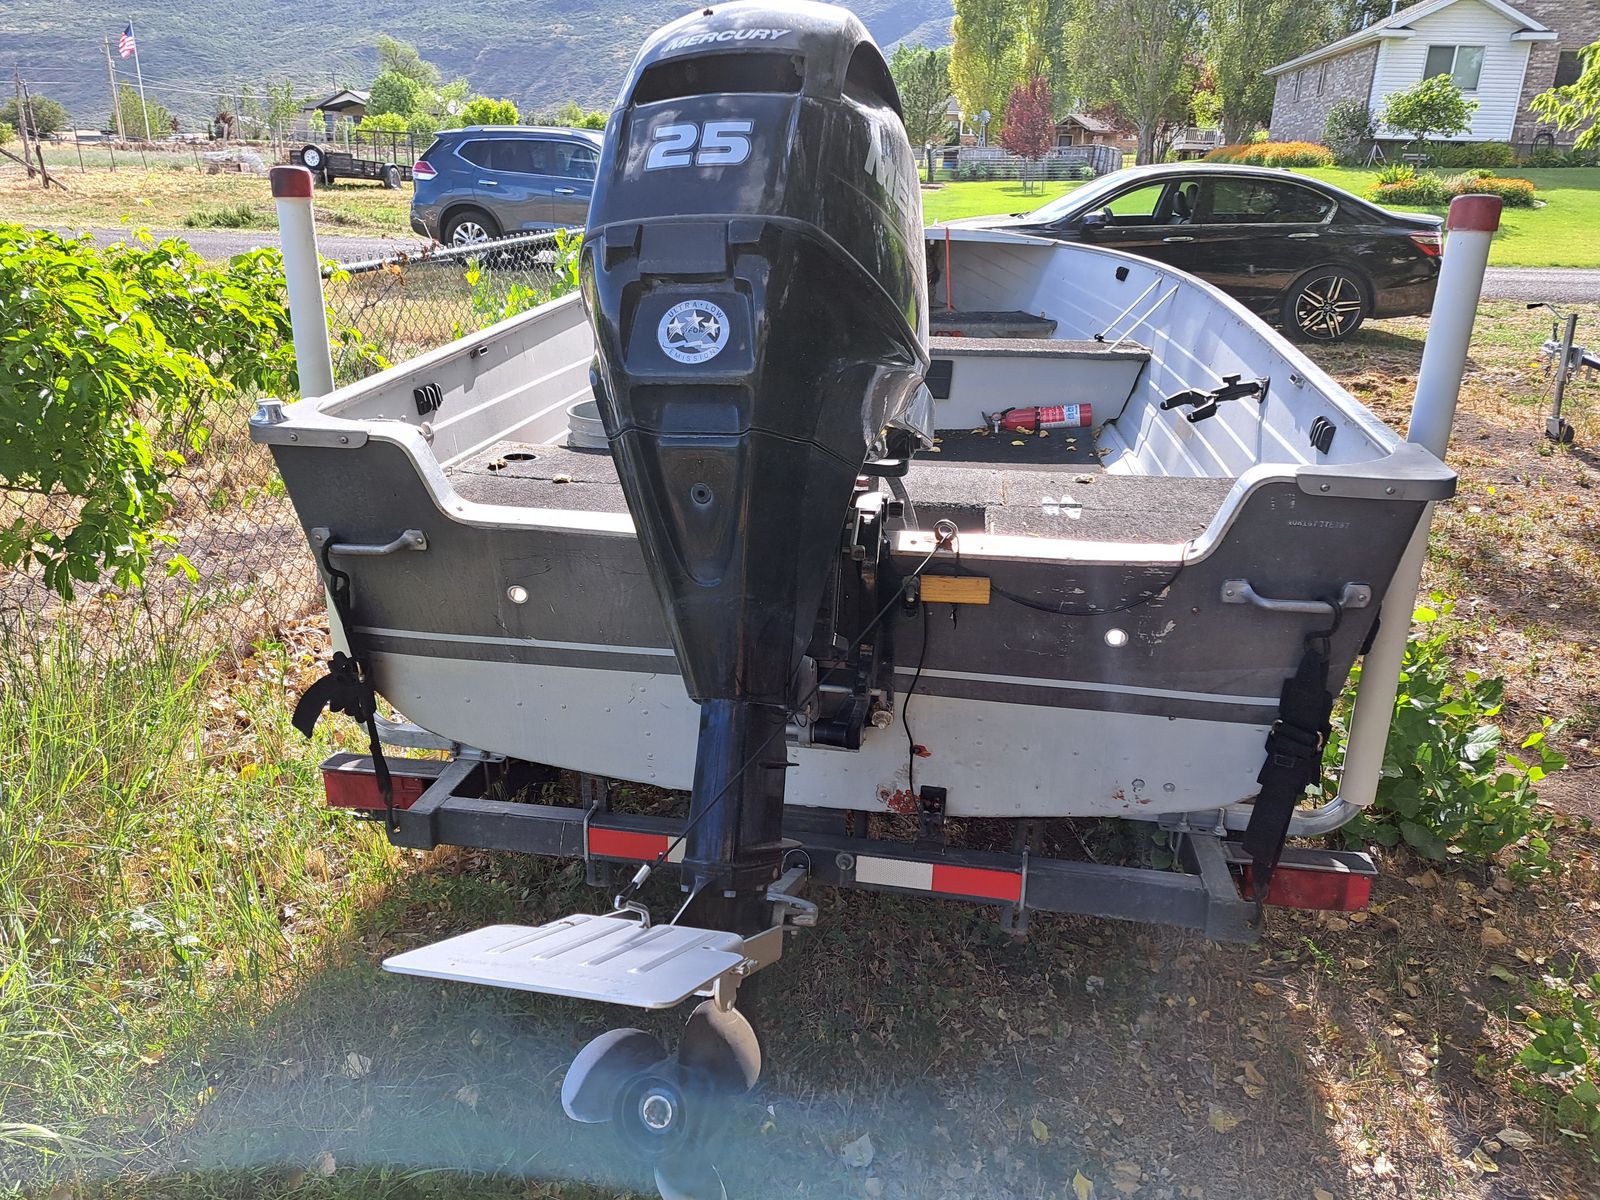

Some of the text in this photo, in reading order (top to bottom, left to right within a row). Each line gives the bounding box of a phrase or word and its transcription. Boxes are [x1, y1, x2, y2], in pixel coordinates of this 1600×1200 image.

[663, 28, 792, 52] MERCURY
[645, 120, 753, 171] 25
[668, 302, 724, 319] ULTRA LOW
[669, 349, 717, 362] EMISSION
